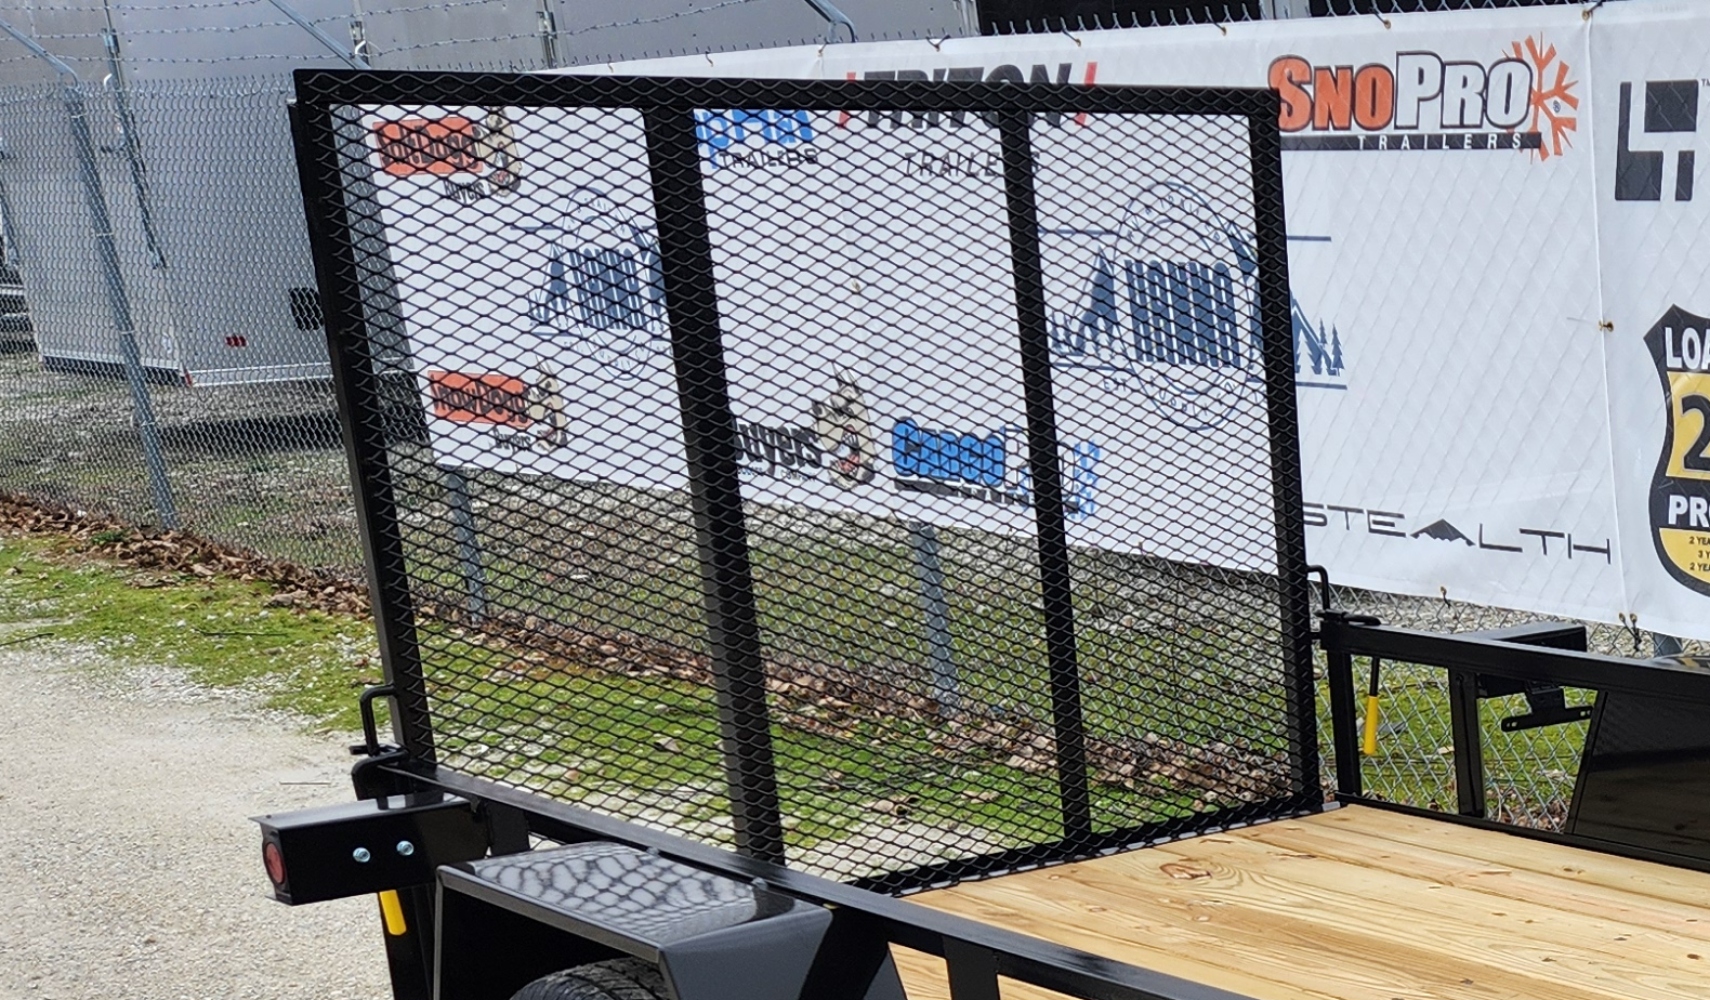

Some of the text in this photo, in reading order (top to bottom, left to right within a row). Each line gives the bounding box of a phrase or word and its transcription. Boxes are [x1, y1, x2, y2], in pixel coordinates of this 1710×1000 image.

[1358, 133, 1522, 151] TRAILERS
[905, 151, 1040, 177] TRAILES
[1123, 260, 1241, 368] HANNA
[1689, 536, 1695, 545] 2
[1698, 550, 1703, 559] 3
[1689, 562, 1695, 571] 2
